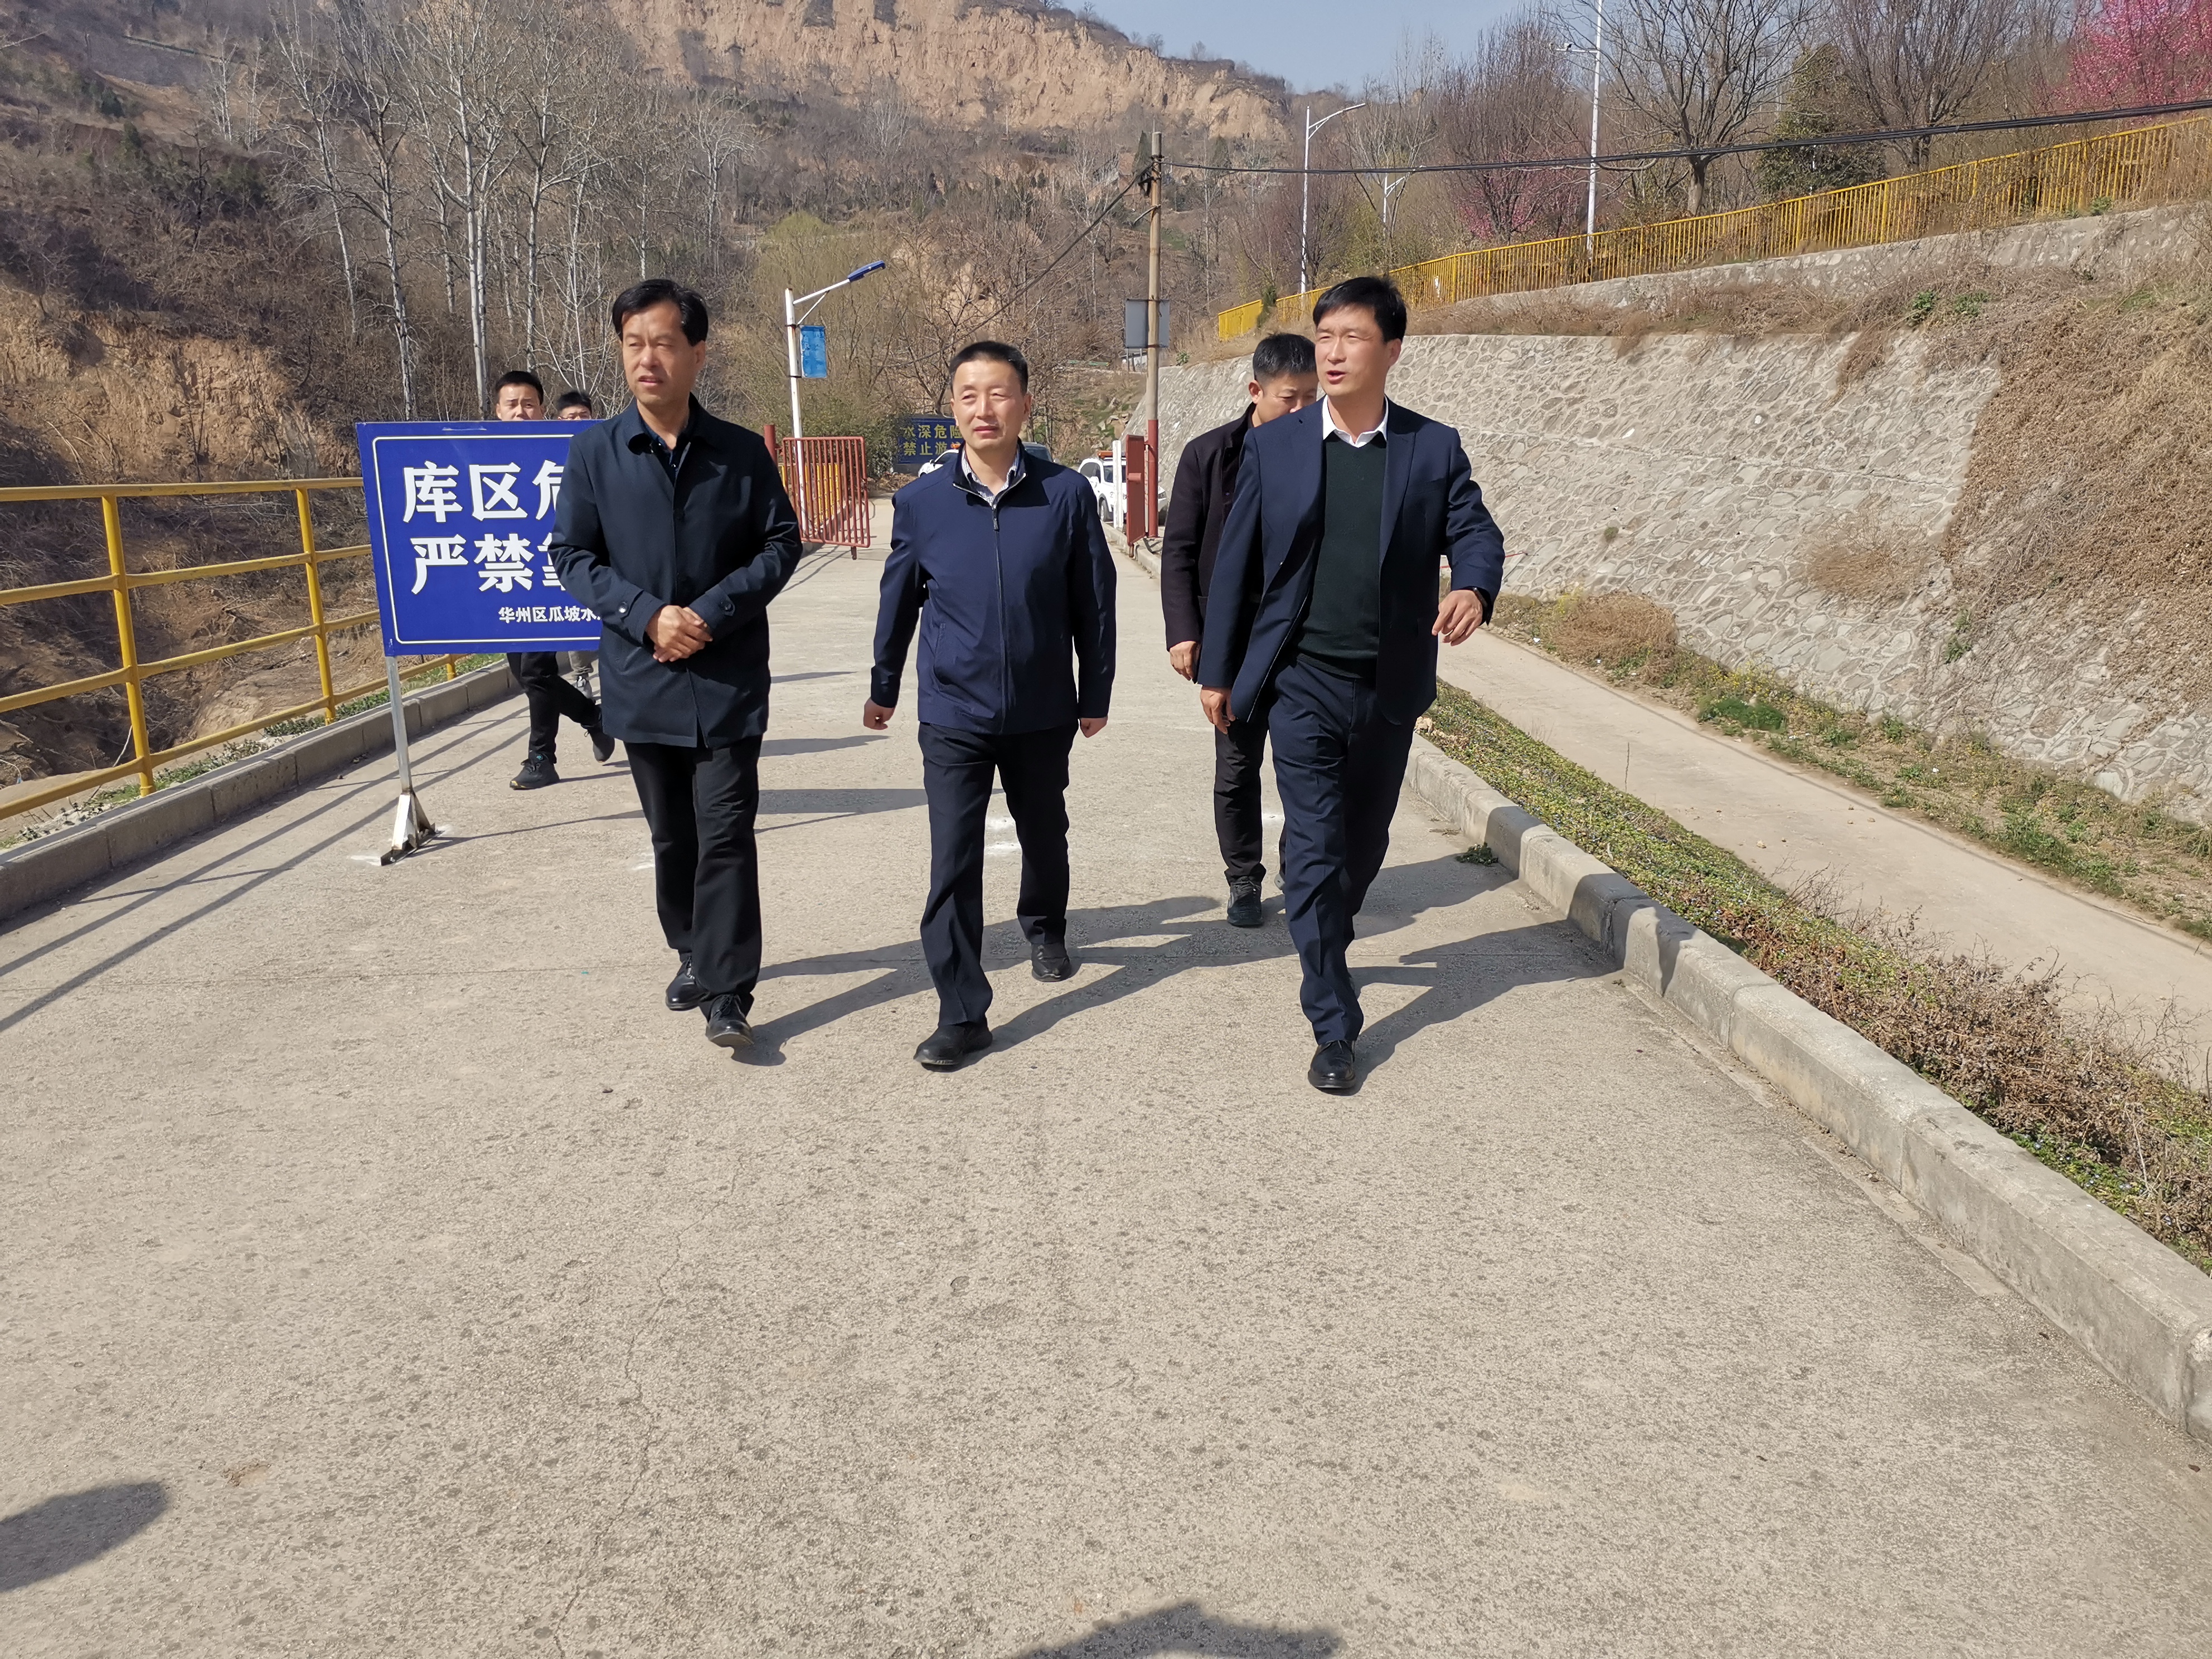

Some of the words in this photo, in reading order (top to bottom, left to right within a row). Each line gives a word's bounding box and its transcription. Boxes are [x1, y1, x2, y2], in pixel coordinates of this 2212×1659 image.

[901, 424, 963, 439] 水深危险
[903, 441, 961, 456] 禁止游
[498, 605, 601, 624] 华州区瓜坡水
